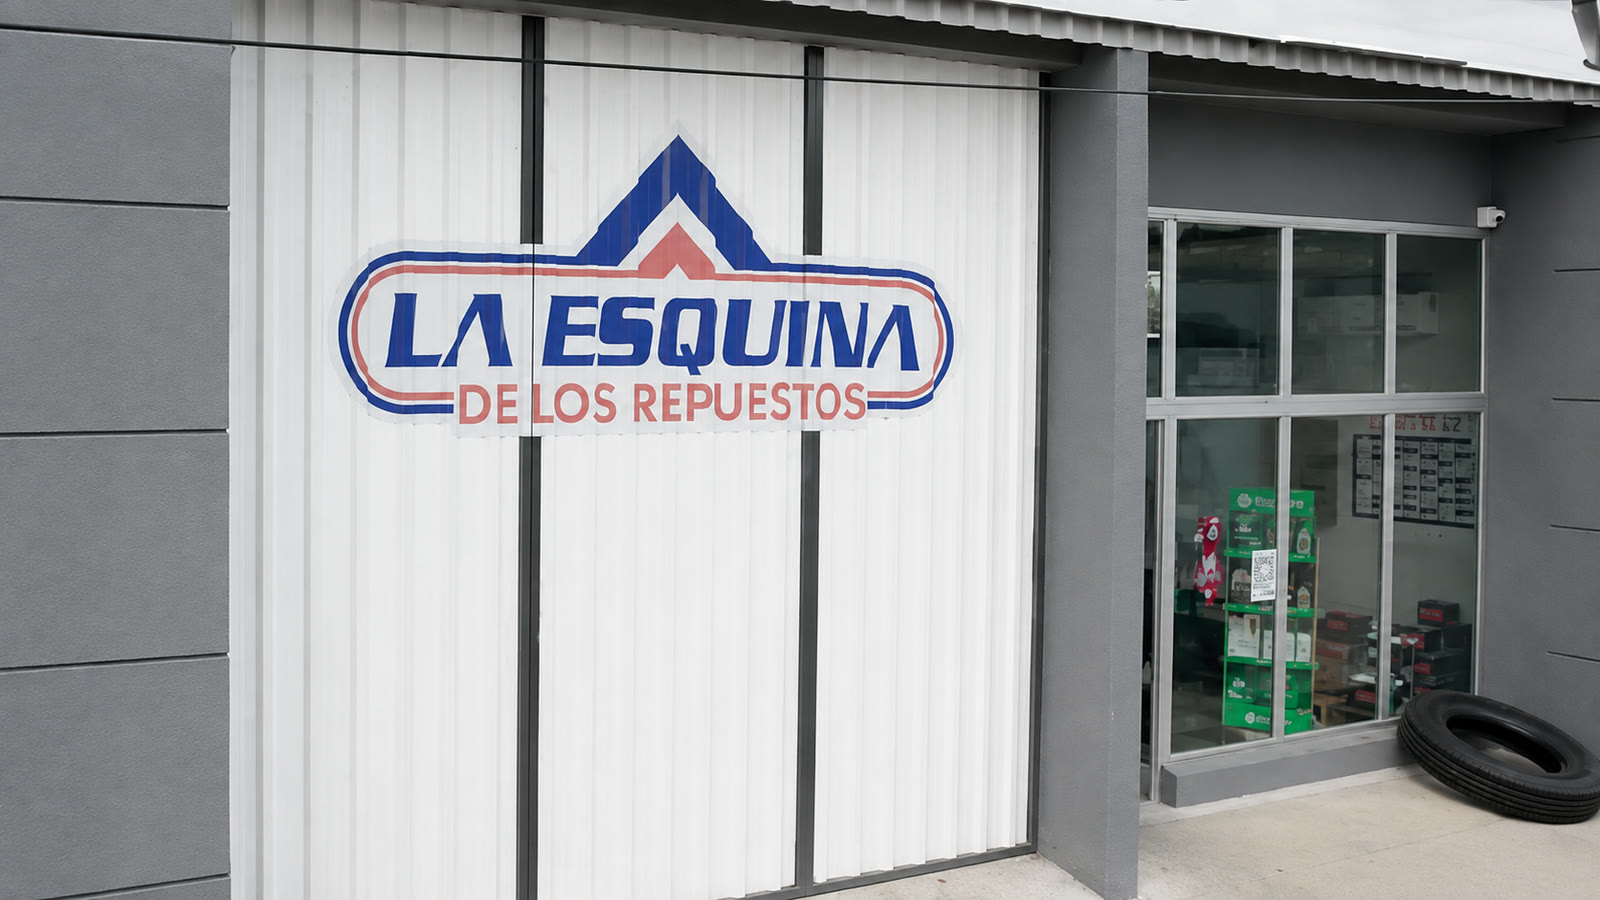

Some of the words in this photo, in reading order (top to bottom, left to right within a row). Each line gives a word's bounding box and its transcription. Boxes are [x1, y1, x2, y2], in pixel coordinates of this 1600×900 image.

[384, 293, 513, 368] LA
[541, 294, 920, 376] ESQUINA
[459, 384, 518, 424] DE
[532, 382, 617, 424] LOS
[633, 382, 866, 423] REPUESTOS
